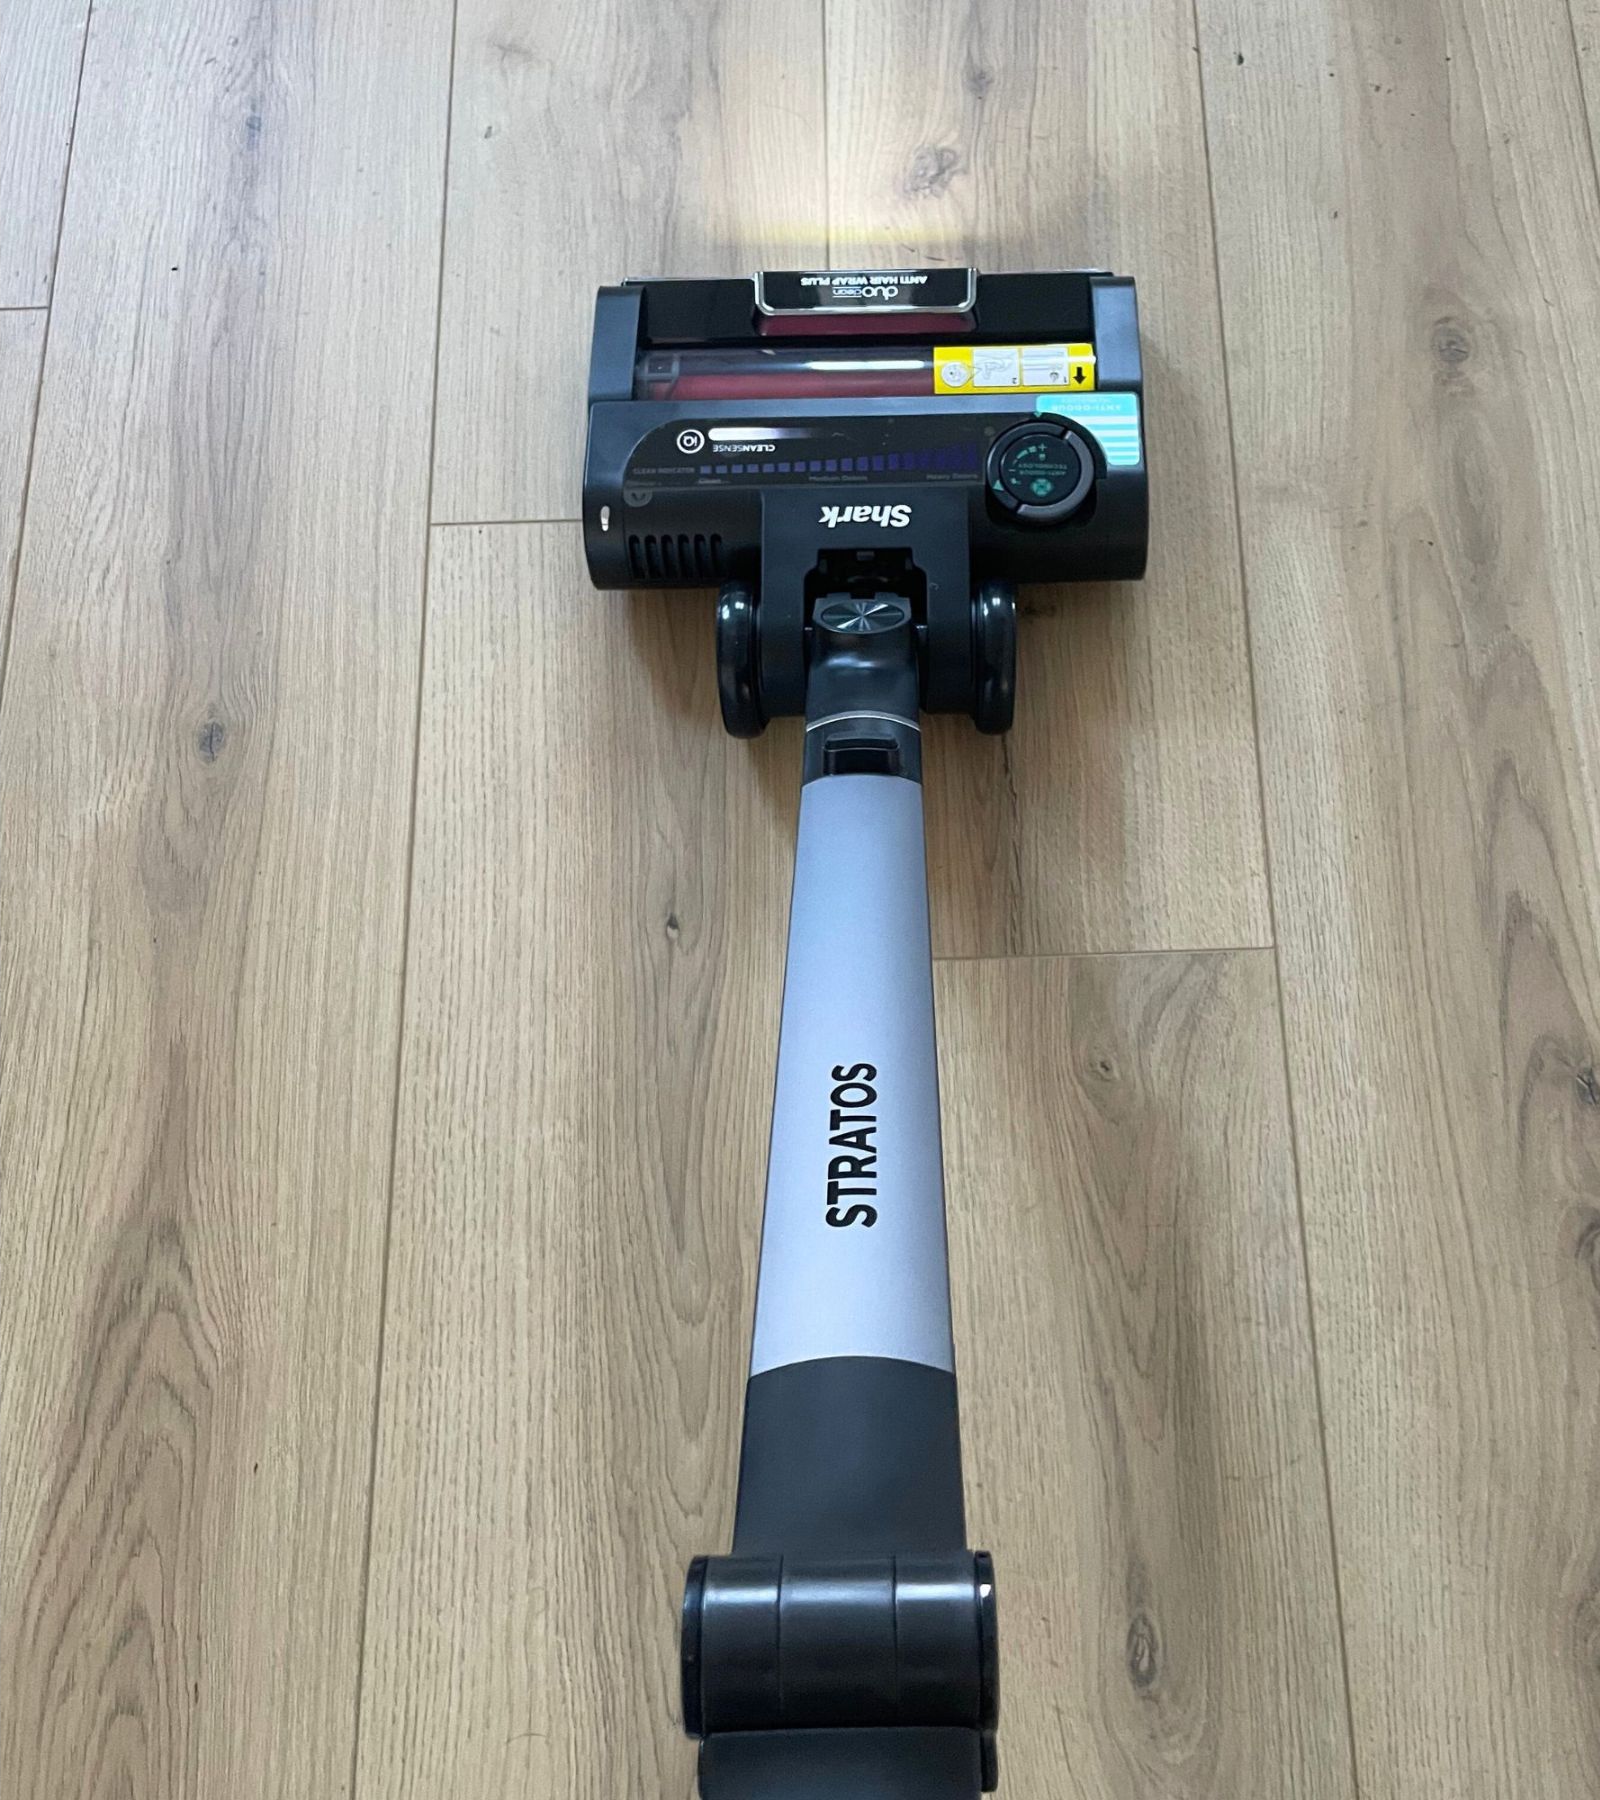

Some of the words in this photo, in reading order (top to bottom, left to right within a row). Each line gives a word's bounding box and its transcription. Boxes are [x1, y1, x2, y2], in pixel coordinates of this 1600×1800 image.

[801, 277, 830, 286] PLUS
[832, 276, 868, 285] WRAP
[870, 276, 898, 285] HAIR
[900, 276, 928, 284] ANTI
[818, 504, 912, 528] Shark
[825, 1063, 878, 1228] STRATOS
